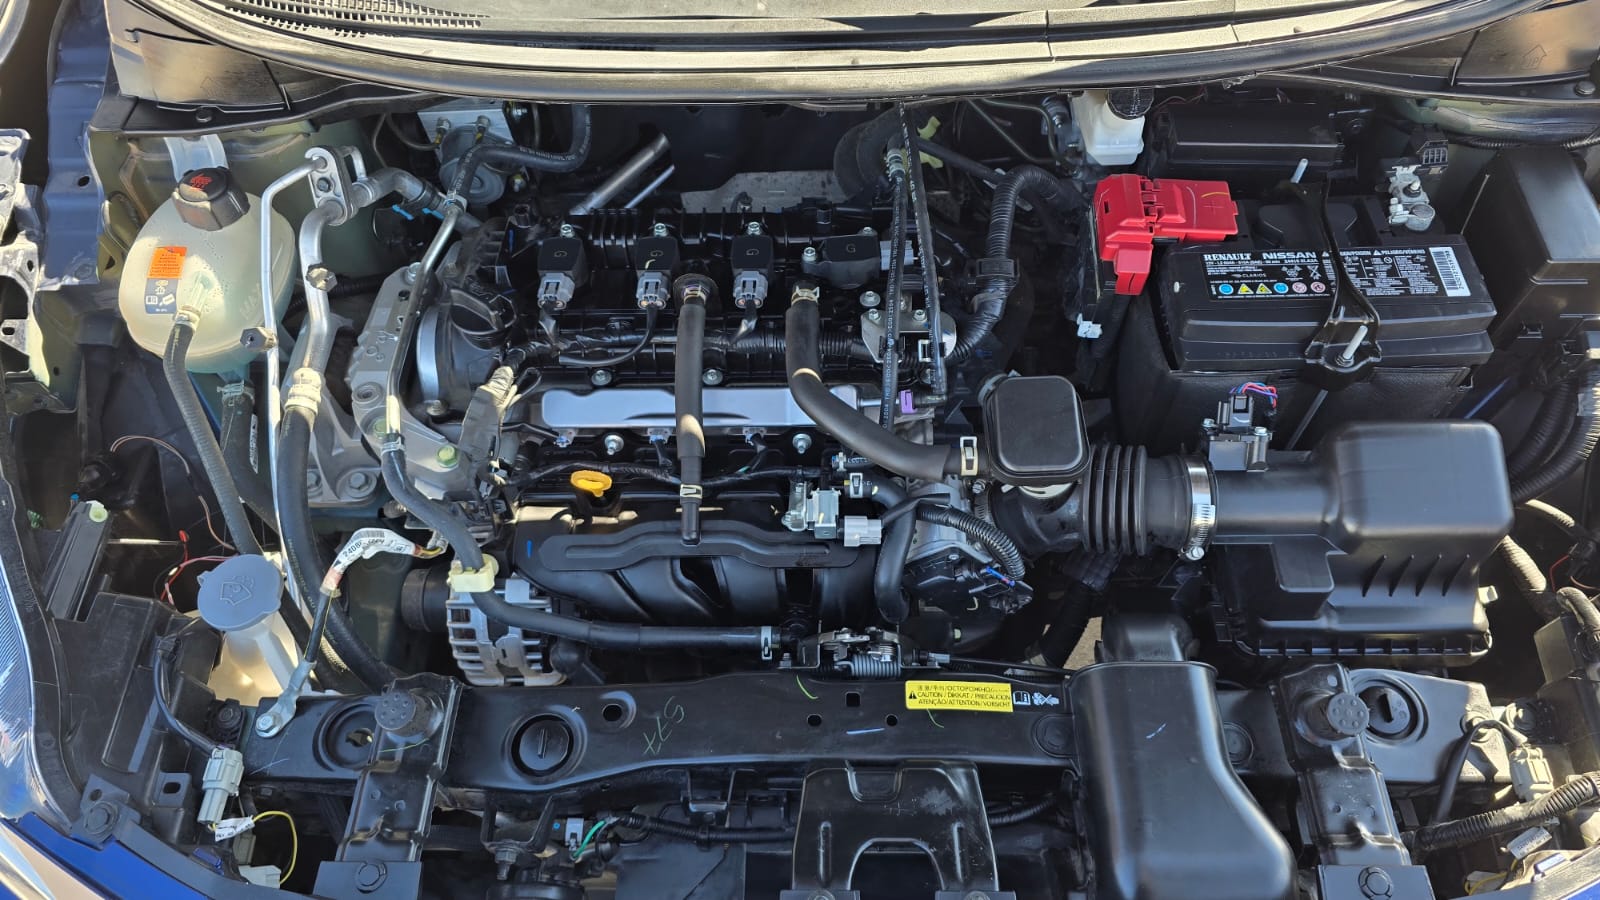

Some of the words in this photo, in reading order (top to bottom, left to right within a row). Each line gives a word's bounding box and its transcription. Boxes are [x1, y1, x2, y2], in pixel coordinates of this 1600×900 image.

[846, 243, 856, 253] G
[1203, 253, 1251, 261] RENAULT
[1262, 252, 1317, 260] NISSAN
